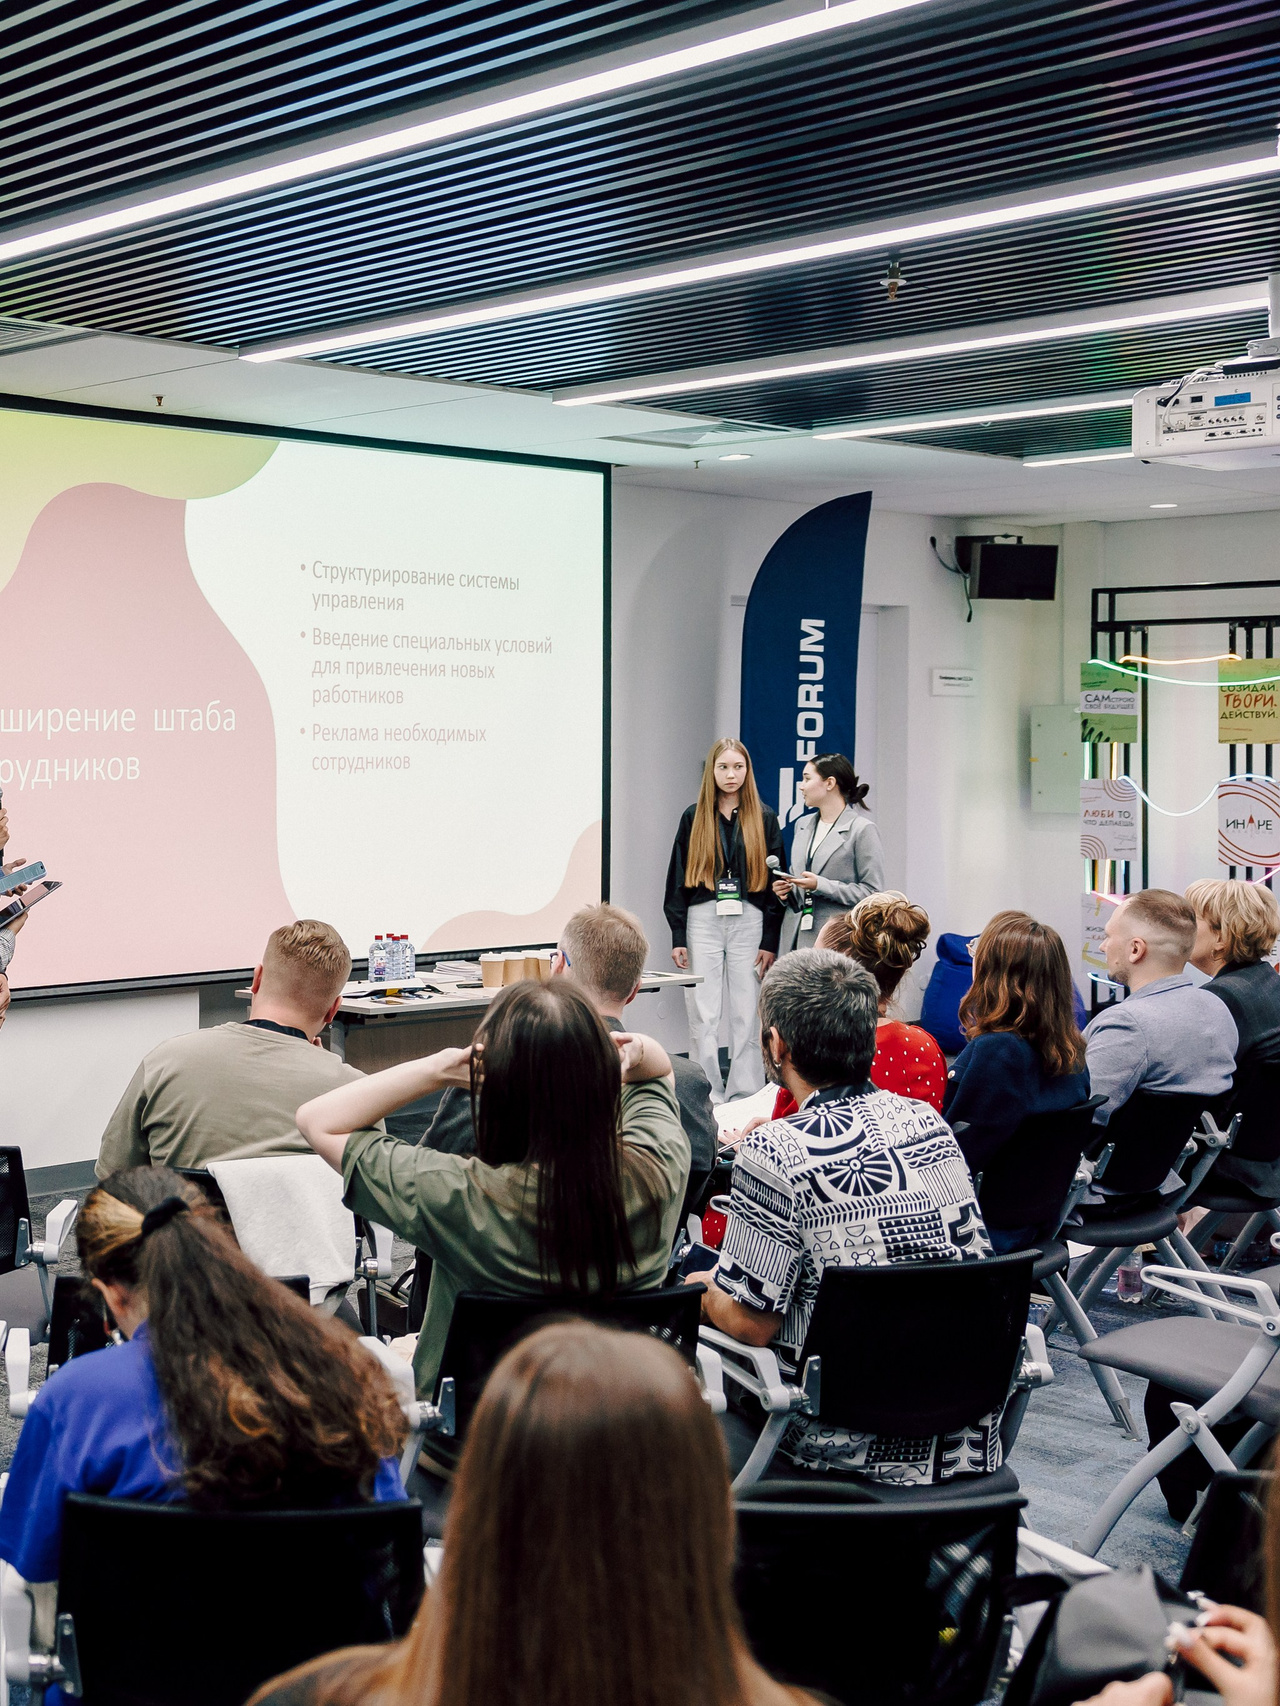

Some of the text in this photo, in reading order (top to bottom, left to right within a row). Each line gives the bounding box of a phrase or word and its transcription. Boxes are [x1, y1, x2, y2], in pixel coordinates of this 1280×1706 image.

[312, 560, 520, 591] Структурирование системы
[311, 592, 405, 612] управления
[312, 627, 553, 656] Введение специальных условий
[311, 659, 496, 679] для привлечения новых
[312, 684, 405, 707] работников
[795, 618, 826, 762] FORUM
[1224, 693, 1278, 709] ТВОРИ.
[153, 699, 237, 732] штаба
[312, 722, 487, 745] Реклама необходимых
[311, 755, 411, 775] сотрудников
[1083, 809, 1115, 818] ЛЮБИ
